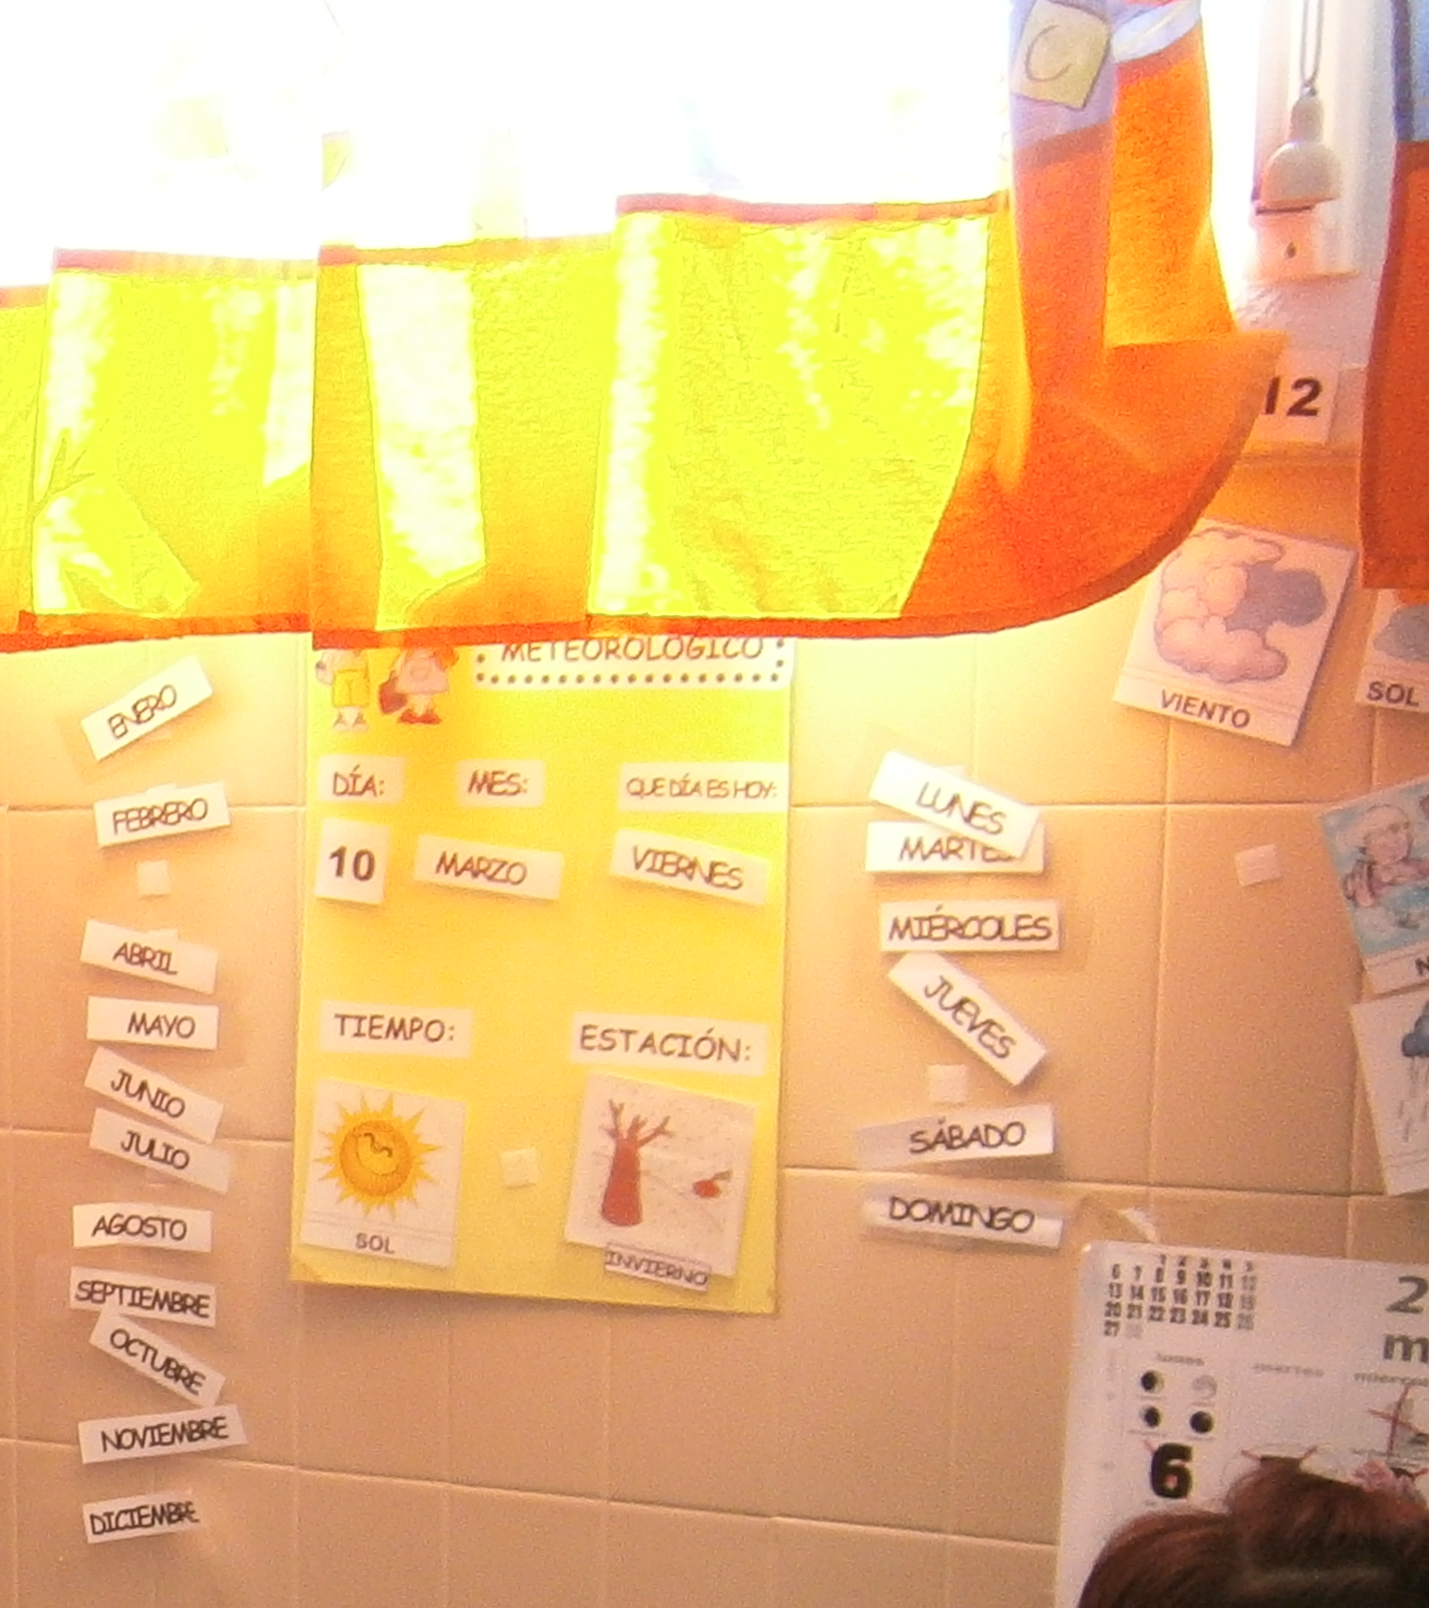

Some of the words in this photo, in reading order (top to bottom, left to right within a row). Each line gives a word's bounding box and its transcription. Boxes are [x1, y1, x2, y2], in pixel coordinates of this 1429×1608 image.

[107, 684, 178, 739] ENERO
[1161, 689, 1251, 728] VIENTO
[1366, 681, 1420, 706] SOL
[333, 764, 385, 798] DÍA:
[467, 769, 529, 796] MES:
[626, 777, 666, 799] QUE
[707, 779, 731, 798] ES
[113, 798, 209, 836] FEBRERO
[916, 781, 1007, 835] LUNES
[329, 845, 375, 882] 10
[435, 850, 528, 887] MARZO
[632, 845, 744, 890] VIERNES
[888, 906, 1052, 941] MIÉRCOLES
[113, 942, 178, 975] ABRIL
[127, 1011, 196, 1039] MAYO
[334, 1013, 456, 1043] TIEMPO:
[923, 974, 1016, 1060] JUEVES
[580, 1023, 752, 1063] ESTACIÓN:
[110, 1068, 186, 1119] JUNIO
[121, 1130, 190, 1170] JULIO
[909, 1117, 1026, 1154] SÁBADO
[91, 1214, 187, 1241] AGOSTO
[888, 1195, 1035, 1234] DOMINGO
[354, 1231, 395, 1255] SOL
[604, 1250, 709, 1286] INVIERNO
[1177, 1269, 1186, 1285] 9
[1196, 1271, 1212, 1287] 10
[1219, 1273, 1233, 1289] 11
[75, 1280, 210, 1319] SEPTIEMBRE
[1109, 1282, 1123, 1299] 13
[1130, 1284, 1144, 1300] 14
[1196, 1290, 1211, 1306] 17
[1127, 1303, 1142, 1319] 21
[1148, 1305, 1166, 1322] 22
[1170, 1307, 1186, 1324] 23
[1192, 1309, 1208, 1325] 24
[1215, 1311, 1231, 1328] 25
[109, 1328, 206, 1397] OCTUBRE
[101, 1415, 229, 1453] NOVIEMBRE
[1151, 1443, 1193, 1499] 6
[89, 1500, 200, 1536] DICIEMBRE
